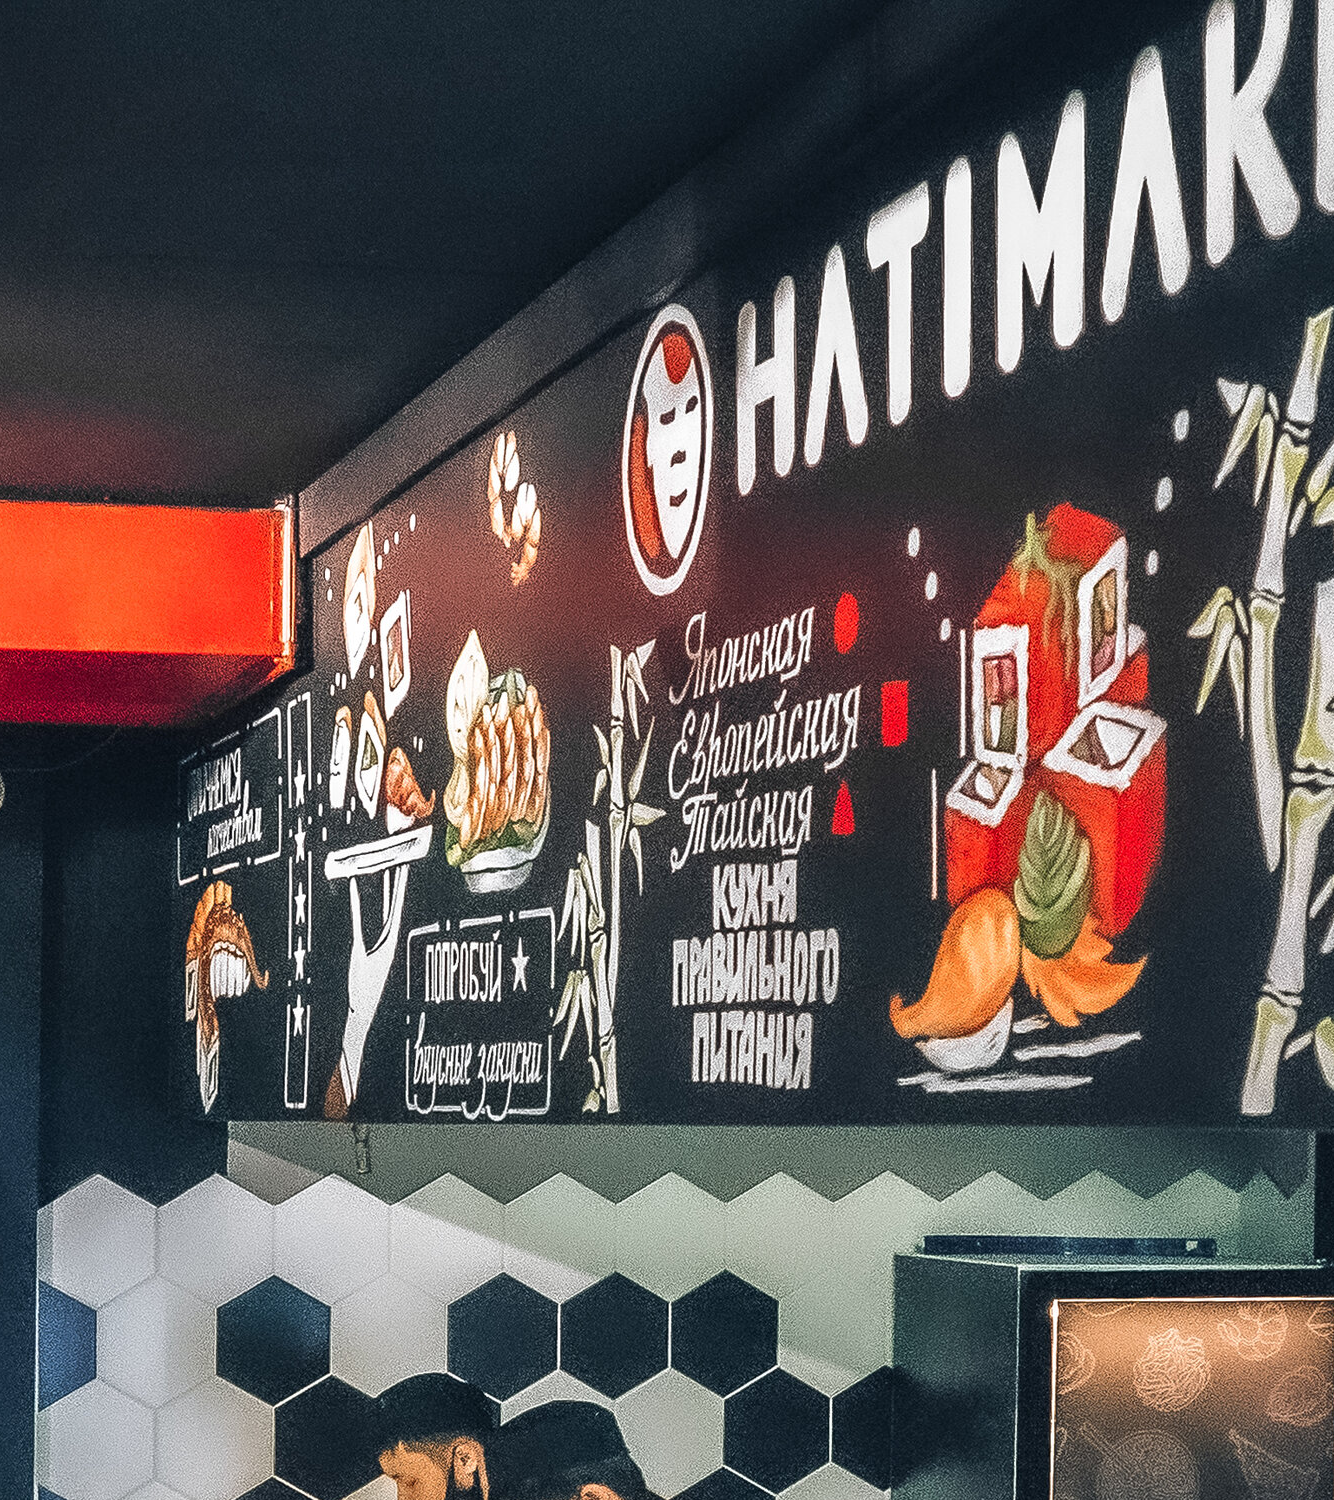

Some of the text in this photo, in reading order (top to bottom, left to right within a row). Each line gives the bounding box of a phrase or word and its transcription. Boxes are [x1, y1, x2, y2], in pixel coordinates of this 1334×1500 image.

[669, 606, 815, 704] Японская
[668, 684, 861, 799] Европейская
[670, 778, 813, 872] Тайская
[713, 859, 798, 930] КУХНЯ
[424, 929, 503, 1004] ПОПРОБУЙ
[671, 928, 840, 1007] ПРАВИЛЬНОГО
[691, 1010, 814, 1090] ПИТАНИЯ
